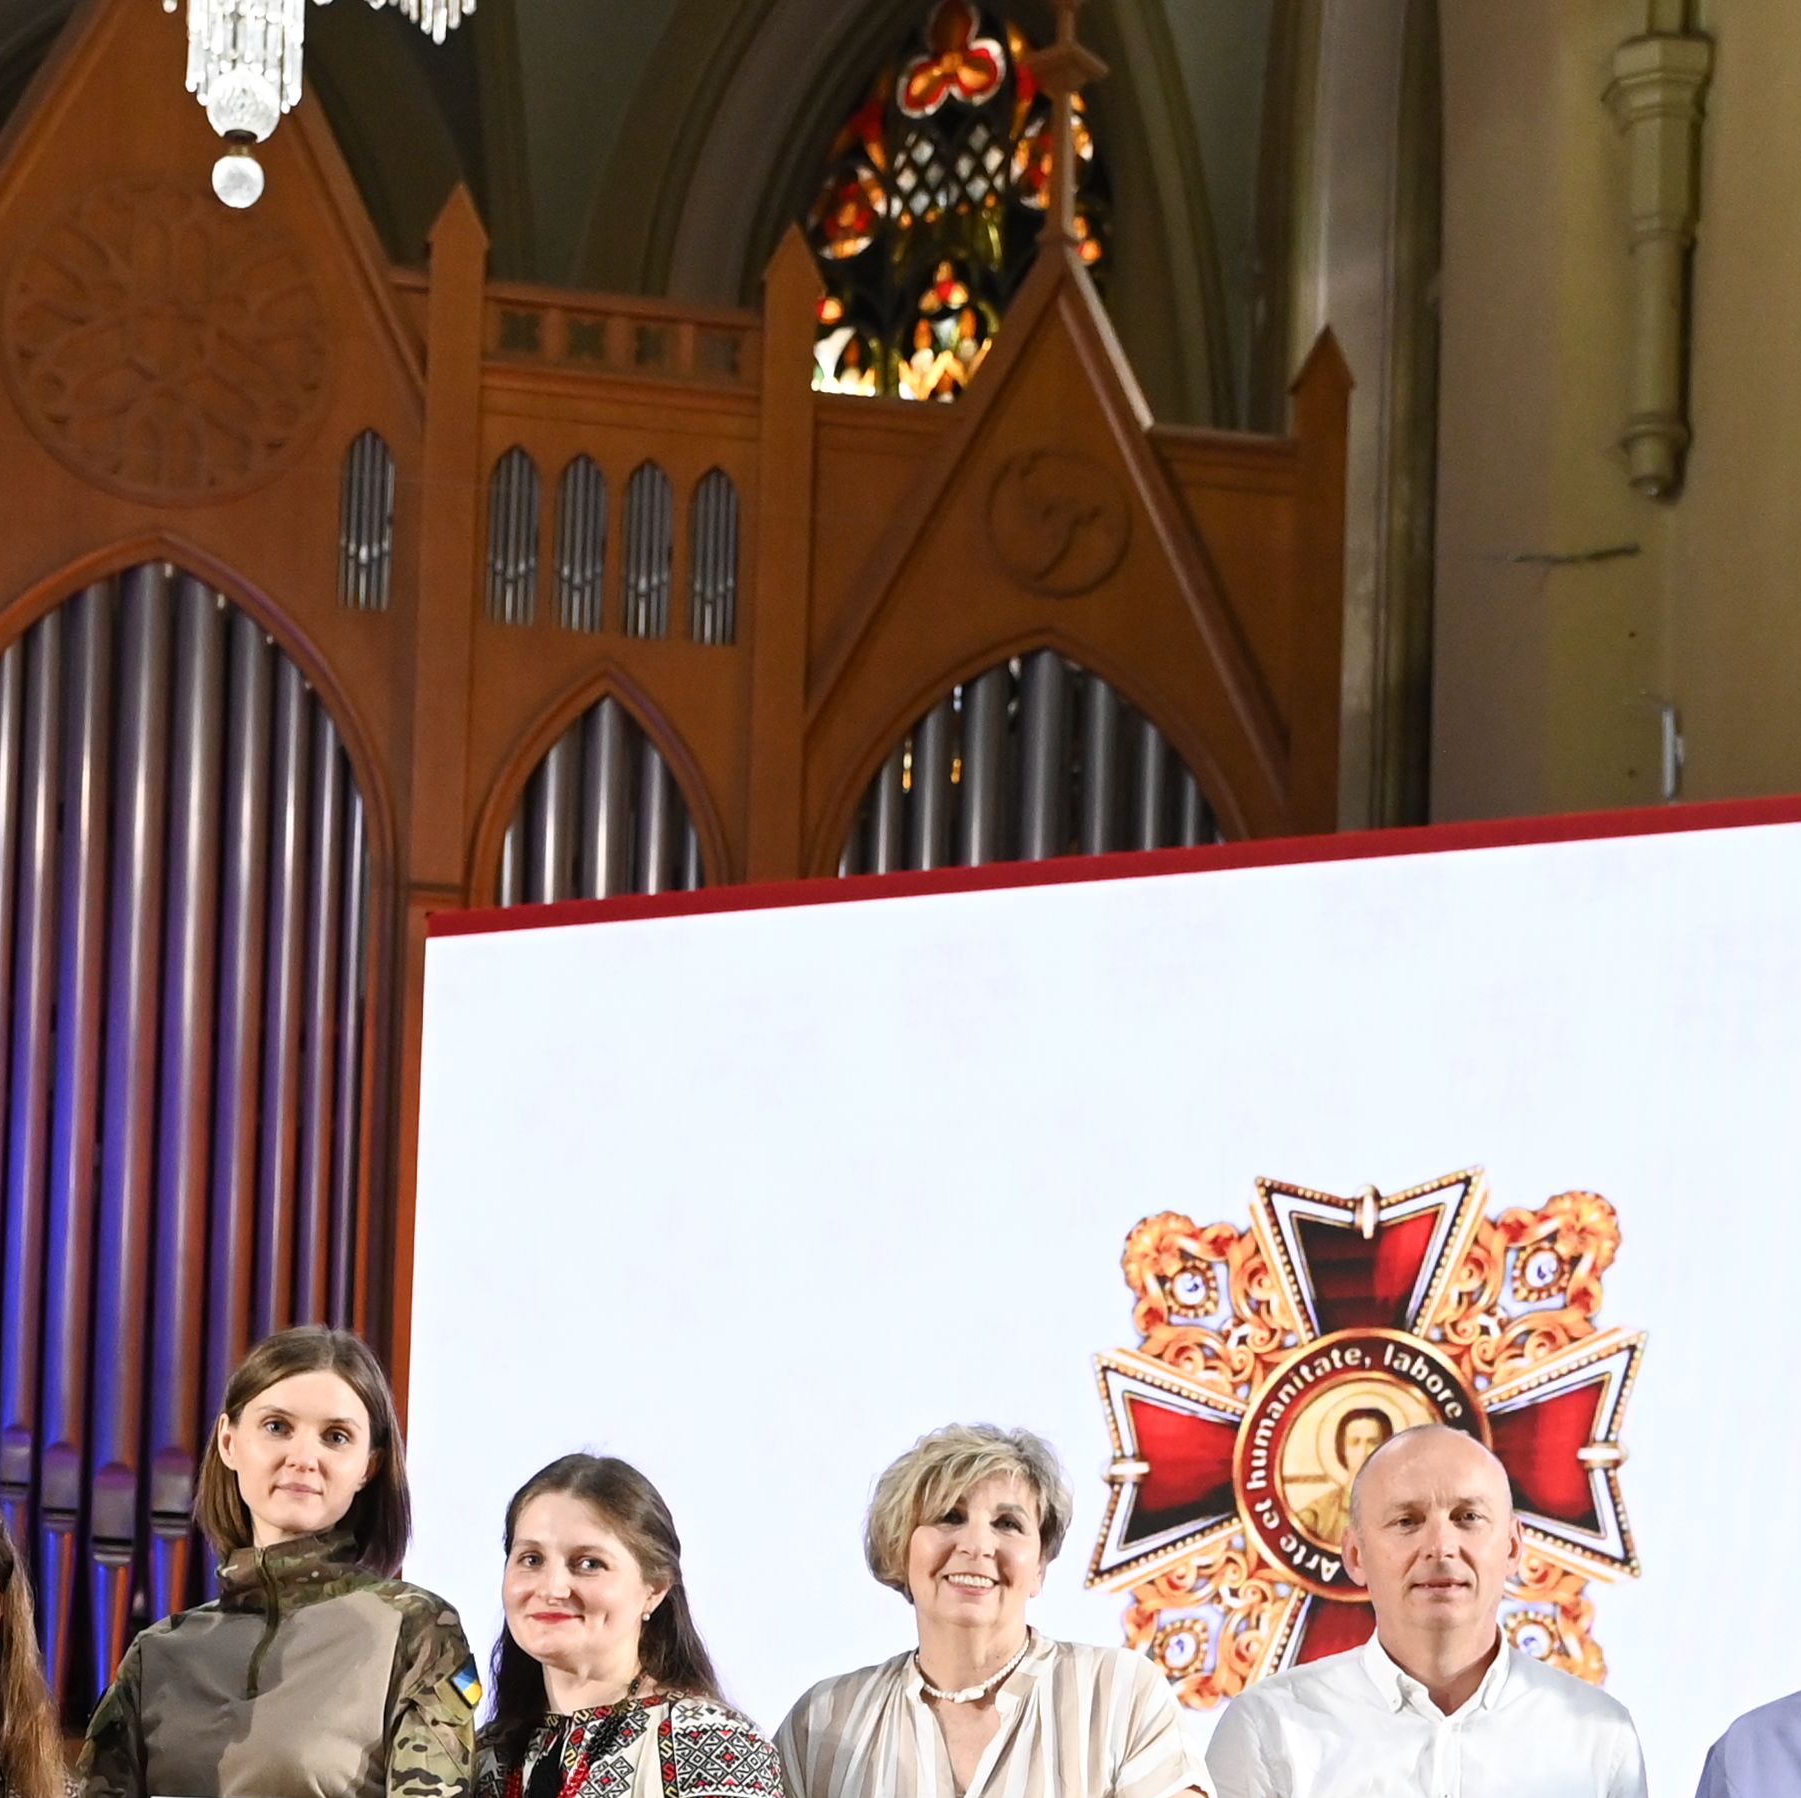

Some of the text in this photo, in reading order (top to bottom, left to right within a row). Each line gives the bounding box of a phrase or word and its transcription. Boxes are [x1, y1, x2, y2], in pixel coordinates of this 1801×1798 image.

[1383, 1343, 1463, 1419] labore
[1254, 1499, 1280, 1529] et
[1279, 1534, 1340, 1582] Arte
